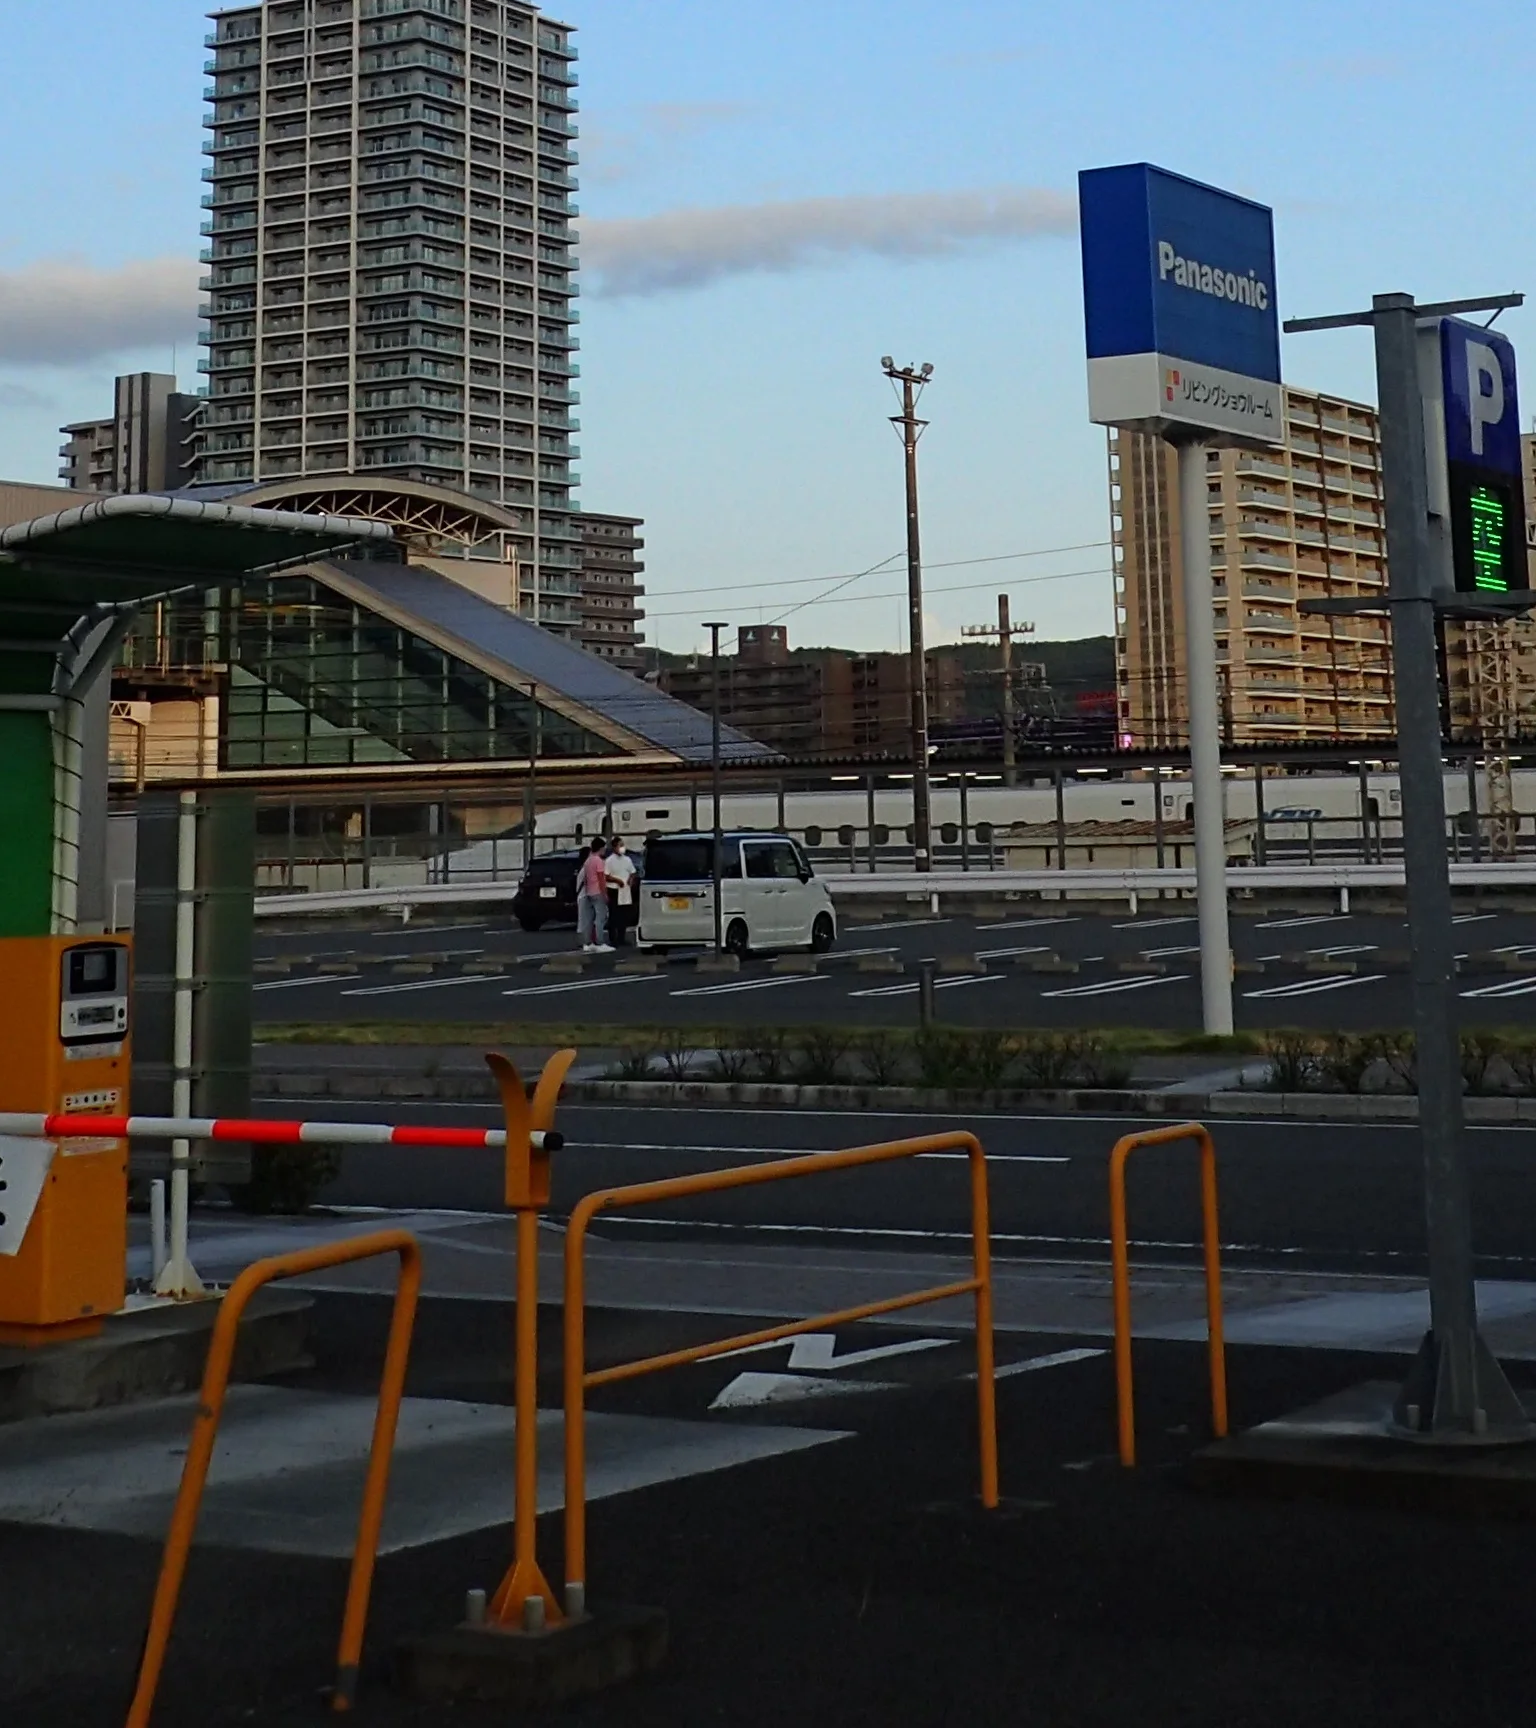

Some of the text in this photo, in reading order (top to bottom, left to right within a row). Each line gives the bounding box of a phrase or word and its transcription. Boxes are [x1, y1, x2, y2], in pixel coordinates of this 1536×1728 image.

[1158, 240, 1268, 311] Panasonic
[1182, 378, 1273, 420] リビングショウルーム
[1464, 337, 1506, 457] P
